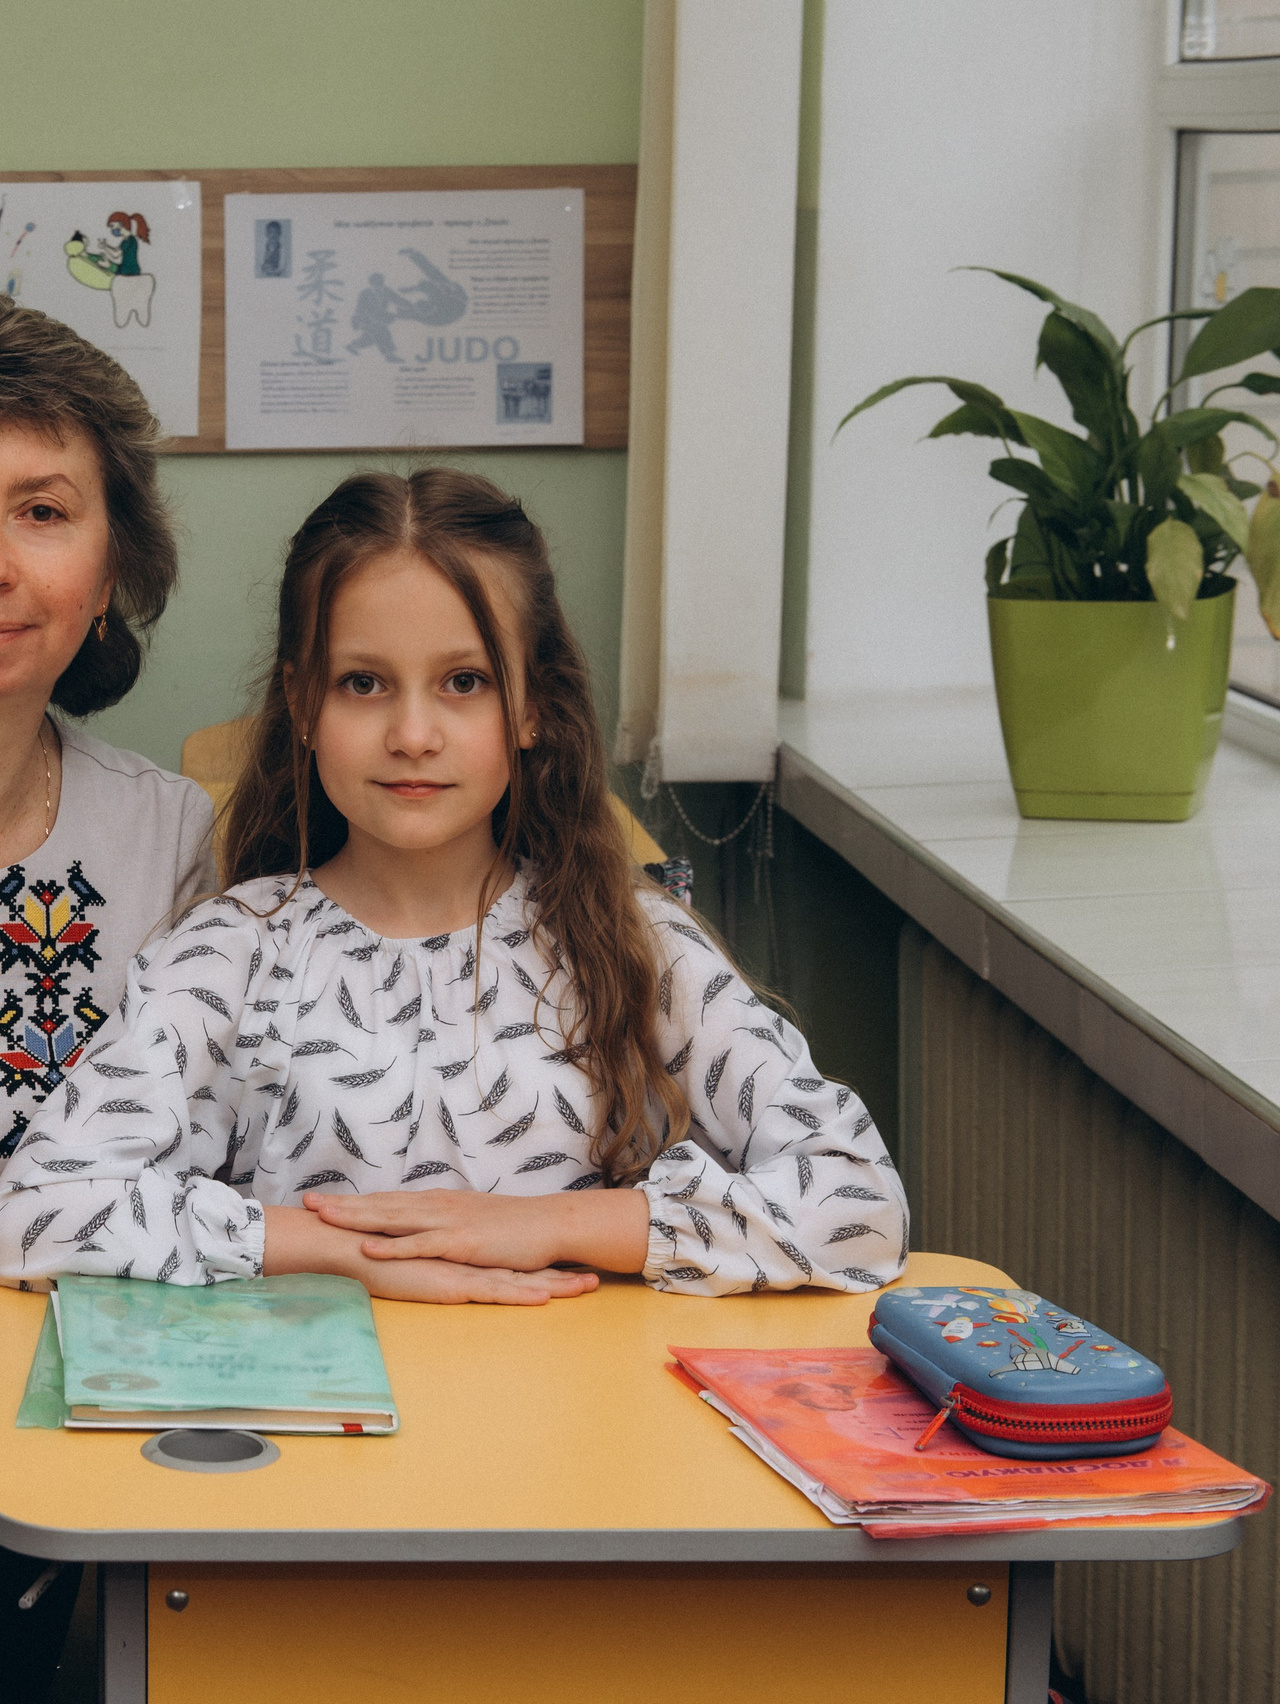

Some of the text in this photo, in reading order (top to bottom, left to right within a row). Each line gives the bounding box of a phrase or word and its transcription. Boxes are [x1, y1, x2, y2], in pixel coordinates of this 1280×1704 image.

[291, 249, 345, 363] 柔道
[414, 336, 520, 364] JUDO
[946, 1459, 1153, 1479] ДОСЛІДЖУЮ
[1160, 1457, 1187, 1468] Я
